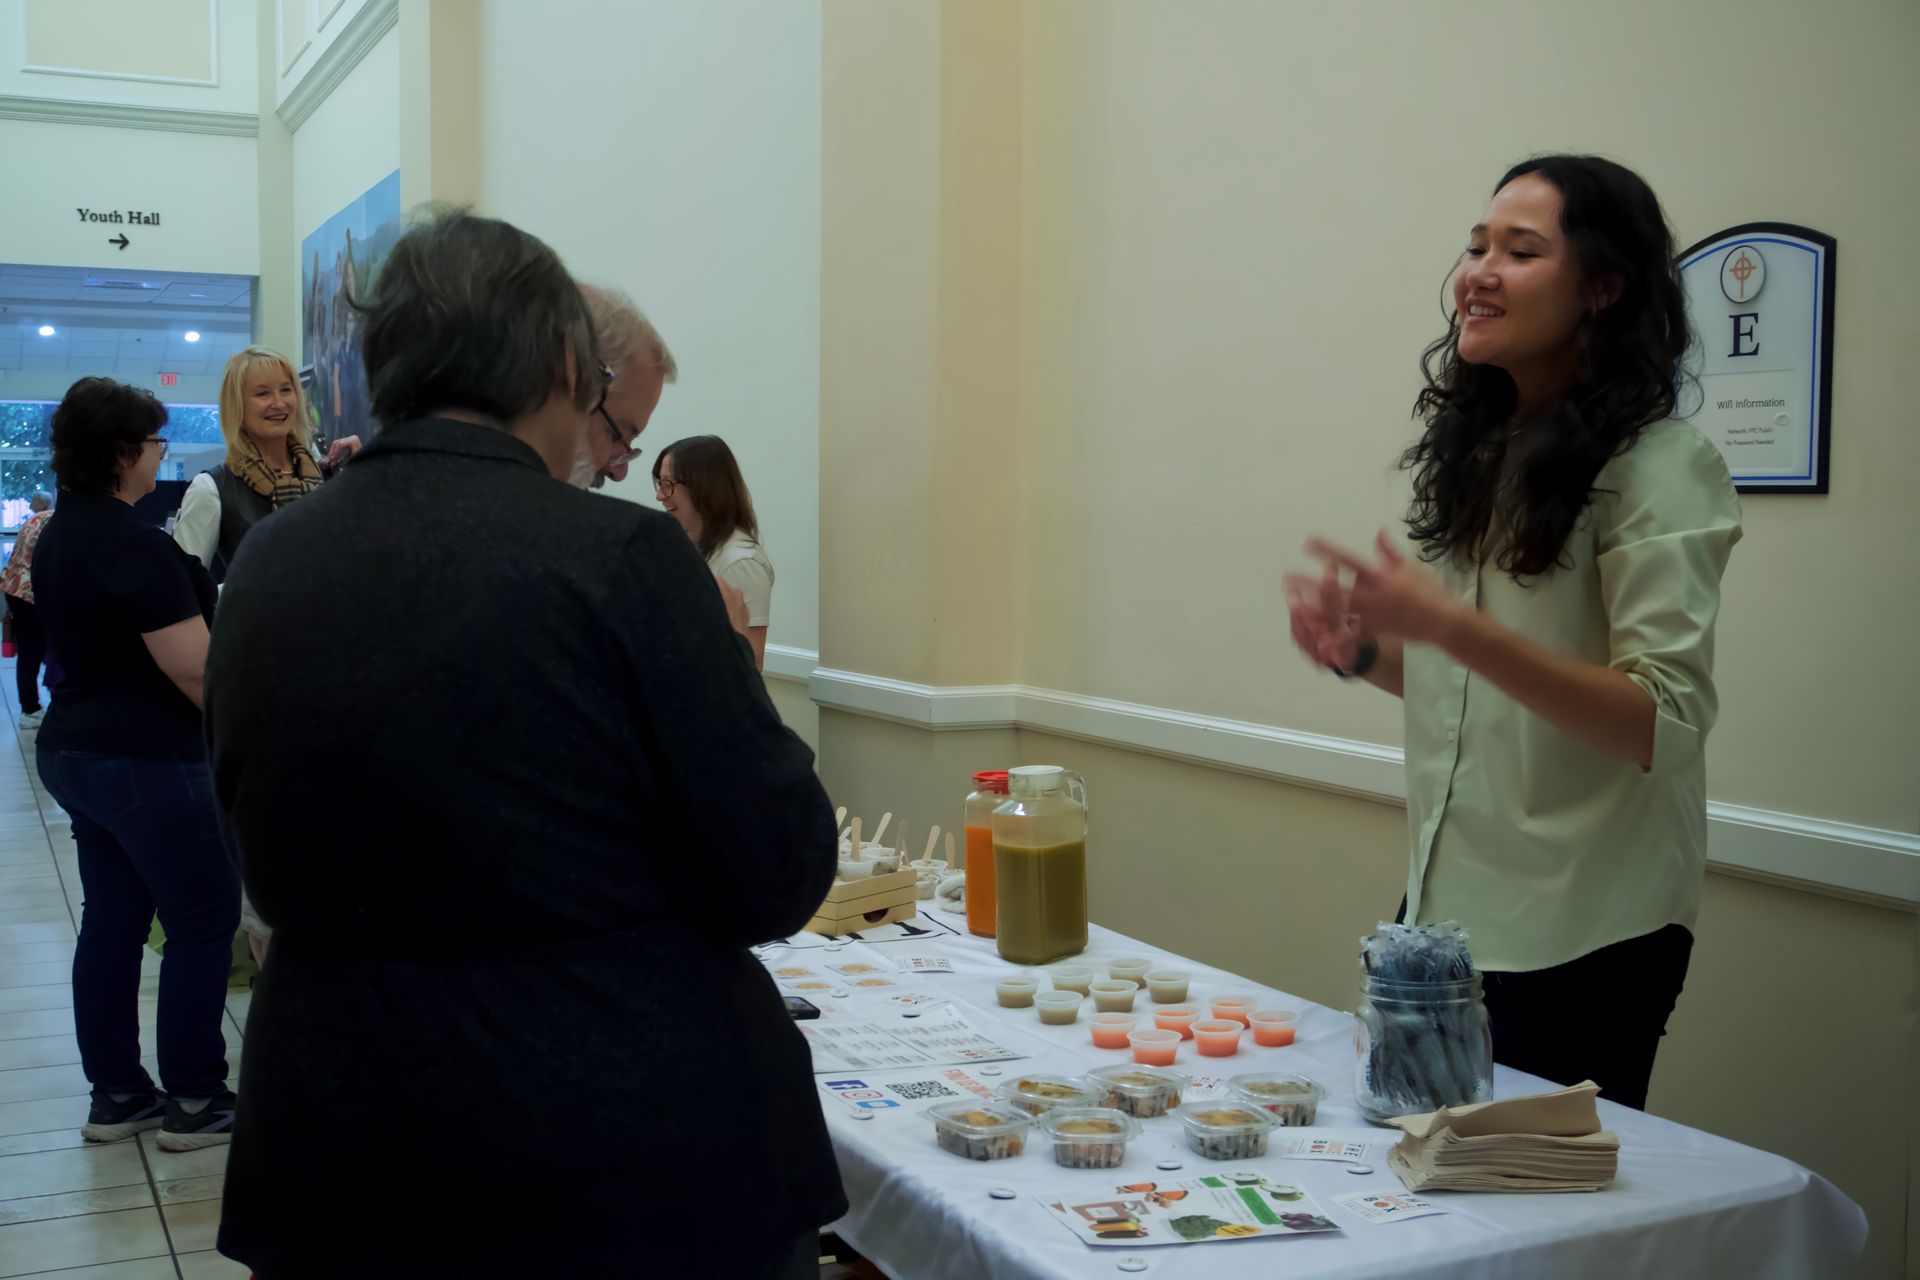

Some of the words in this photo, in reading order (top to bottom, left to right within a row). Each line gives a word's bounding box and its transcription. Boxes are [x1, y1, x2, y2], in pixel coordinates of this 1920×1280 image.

[76, 207, 123, 224] Youth
[127, 211, 160, 226] Hall
[1727, 312, 1760, 358] E
[1717, 399, 1733, 410] Wifi
[1735, 398, 1785, 409] Information
